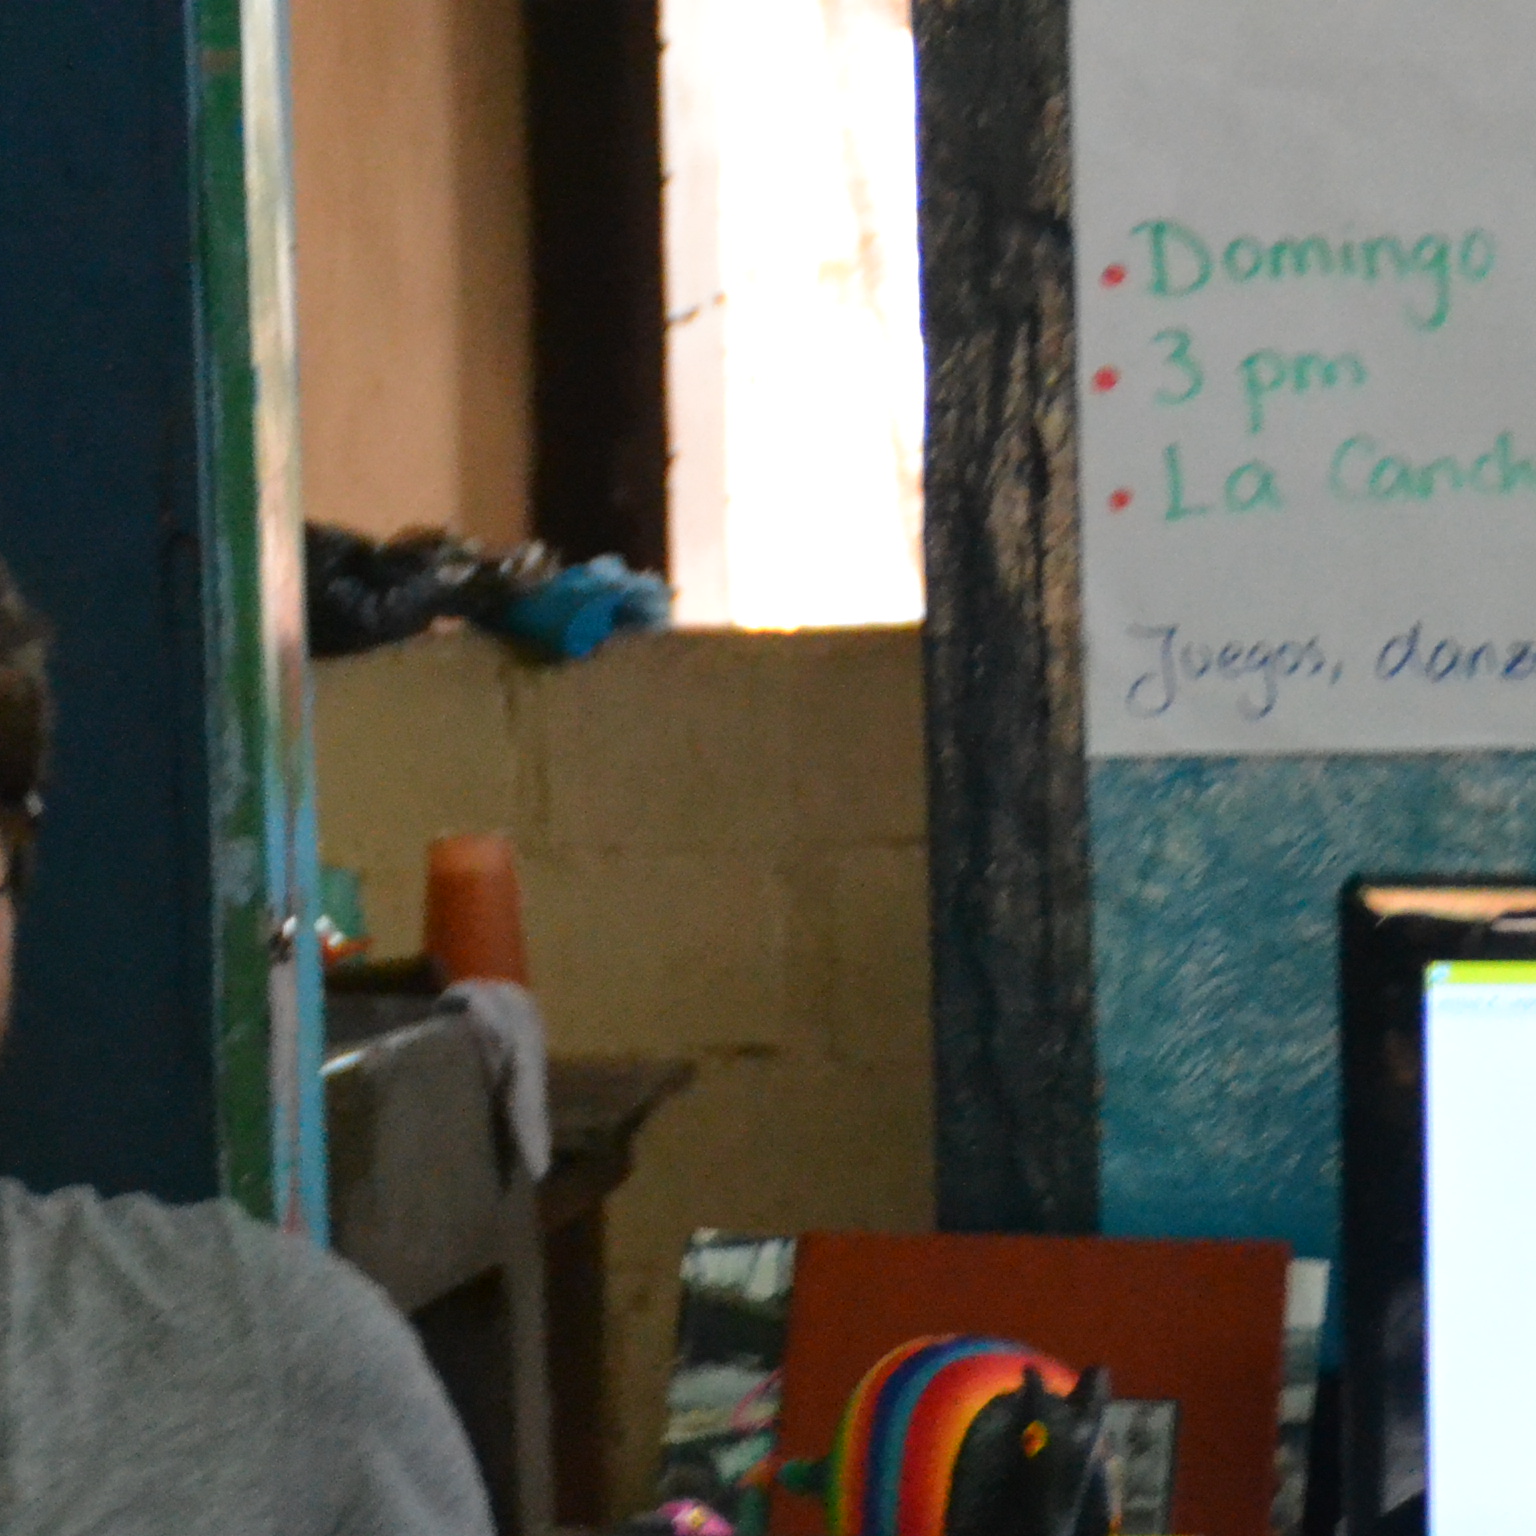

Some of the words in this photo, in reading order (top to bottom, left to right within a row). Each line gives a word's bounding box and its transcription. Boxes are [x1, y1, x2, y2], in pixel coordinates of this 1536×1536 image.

[1131, 217, 1496, 332] Domingo
[1152, 326, 1205, 405] 3
[1239, 347, 1366, 435] pm
[1164, 441, 1284, 522] La
